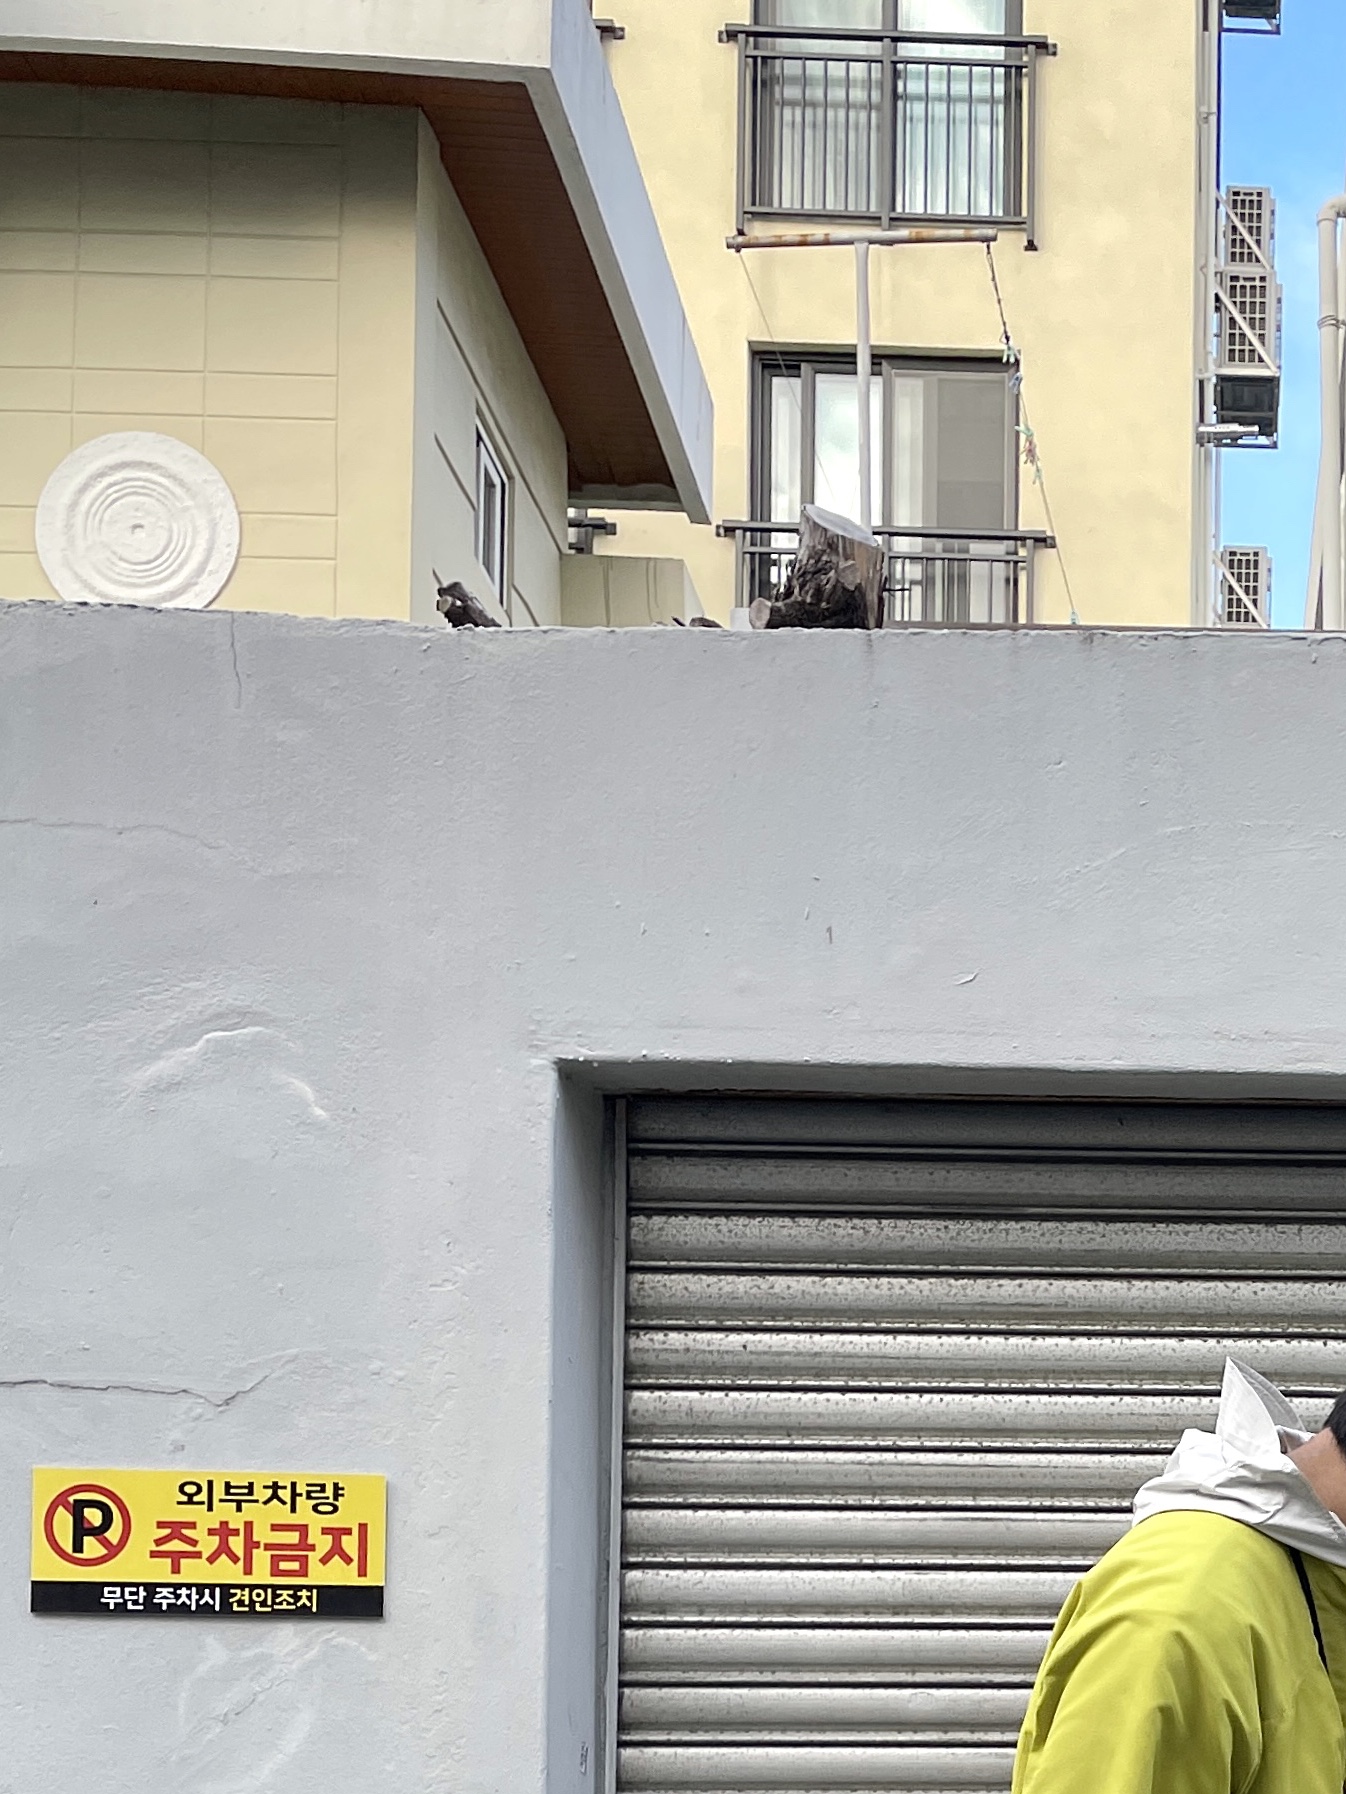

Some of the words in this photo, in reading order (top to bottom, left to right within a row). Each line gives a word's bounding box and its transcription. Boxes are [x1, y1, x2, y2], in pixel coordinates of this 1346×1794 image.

[176, 1480, 345, 1515] 외부차량
[149, 1520, 368, 1578] 주차금지
[100, 1586, 147, 1611] 무단
[152, 1588, 221, 1611] 주차시
[228, 1588, 318, 1612] 견인조치
